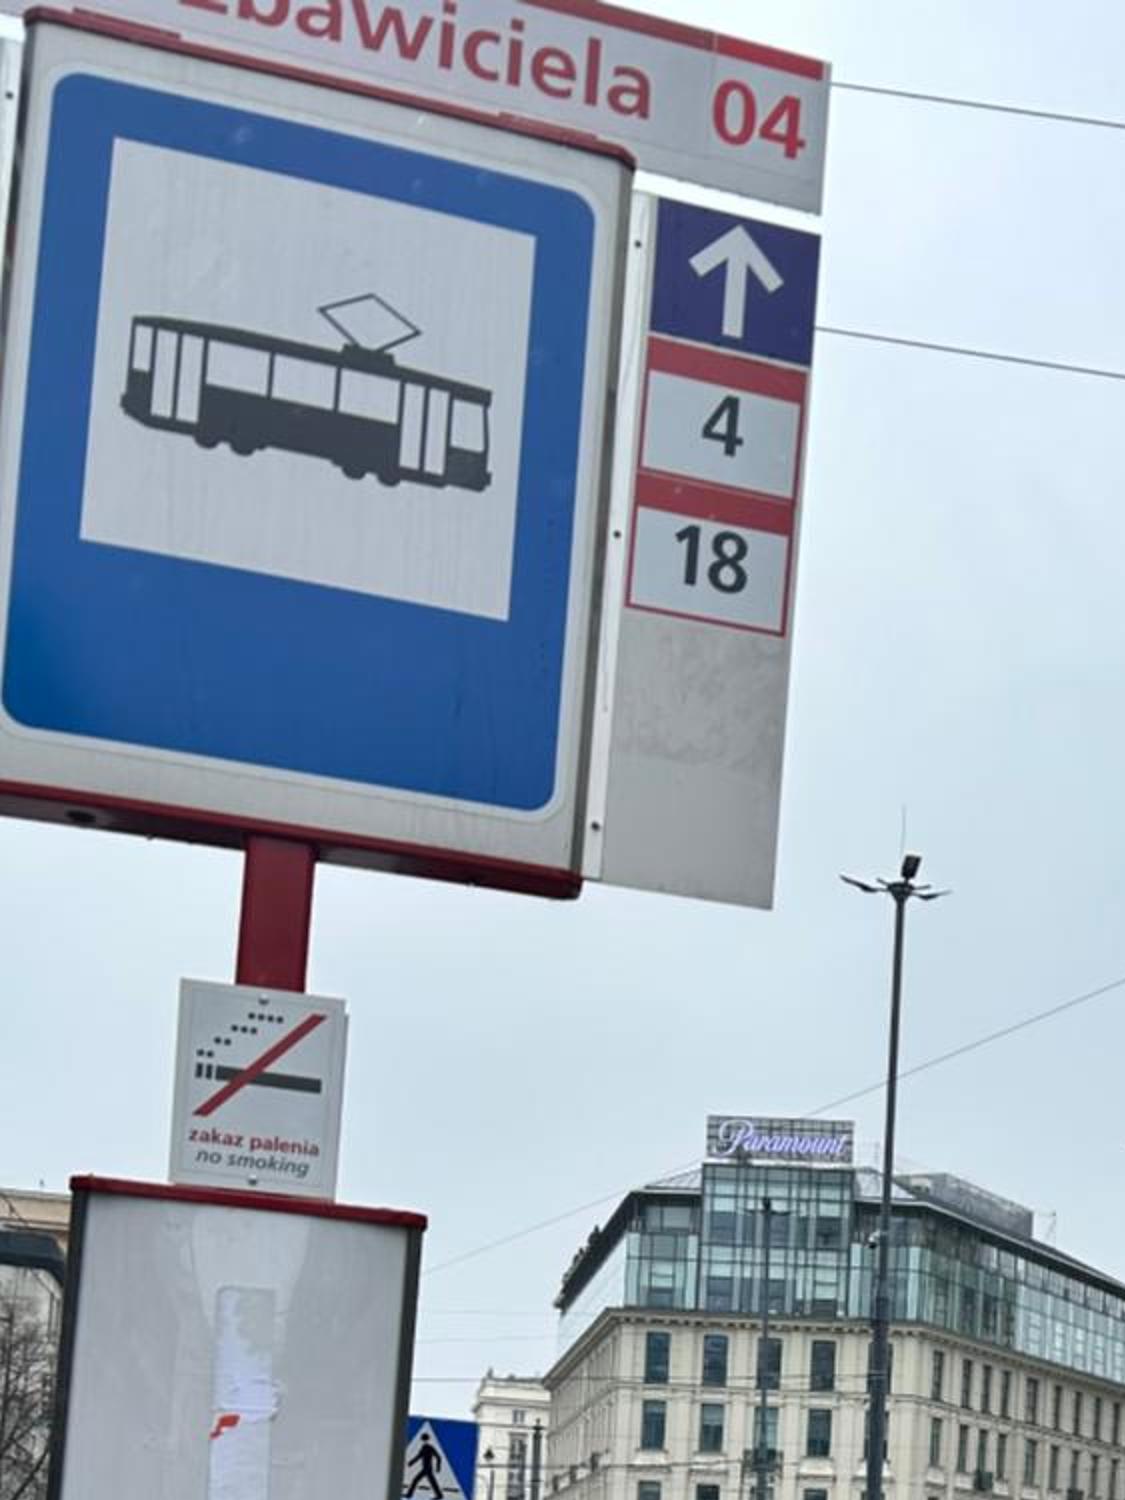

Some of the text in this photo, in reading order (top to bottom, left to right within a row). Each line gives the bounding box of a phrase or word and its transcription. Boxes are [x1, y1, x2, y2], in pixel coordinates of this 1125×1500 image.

[180, 0, 806, 160] awiciela 04
[701, 394, 744, 458] 4
[674, 523, 748, 595] 18
[189, 1127, 320, 1156] zakaz palenia
[713, 1119, 849, 1156] Paramount
[195, 1149, 310, 1178] no smoking
